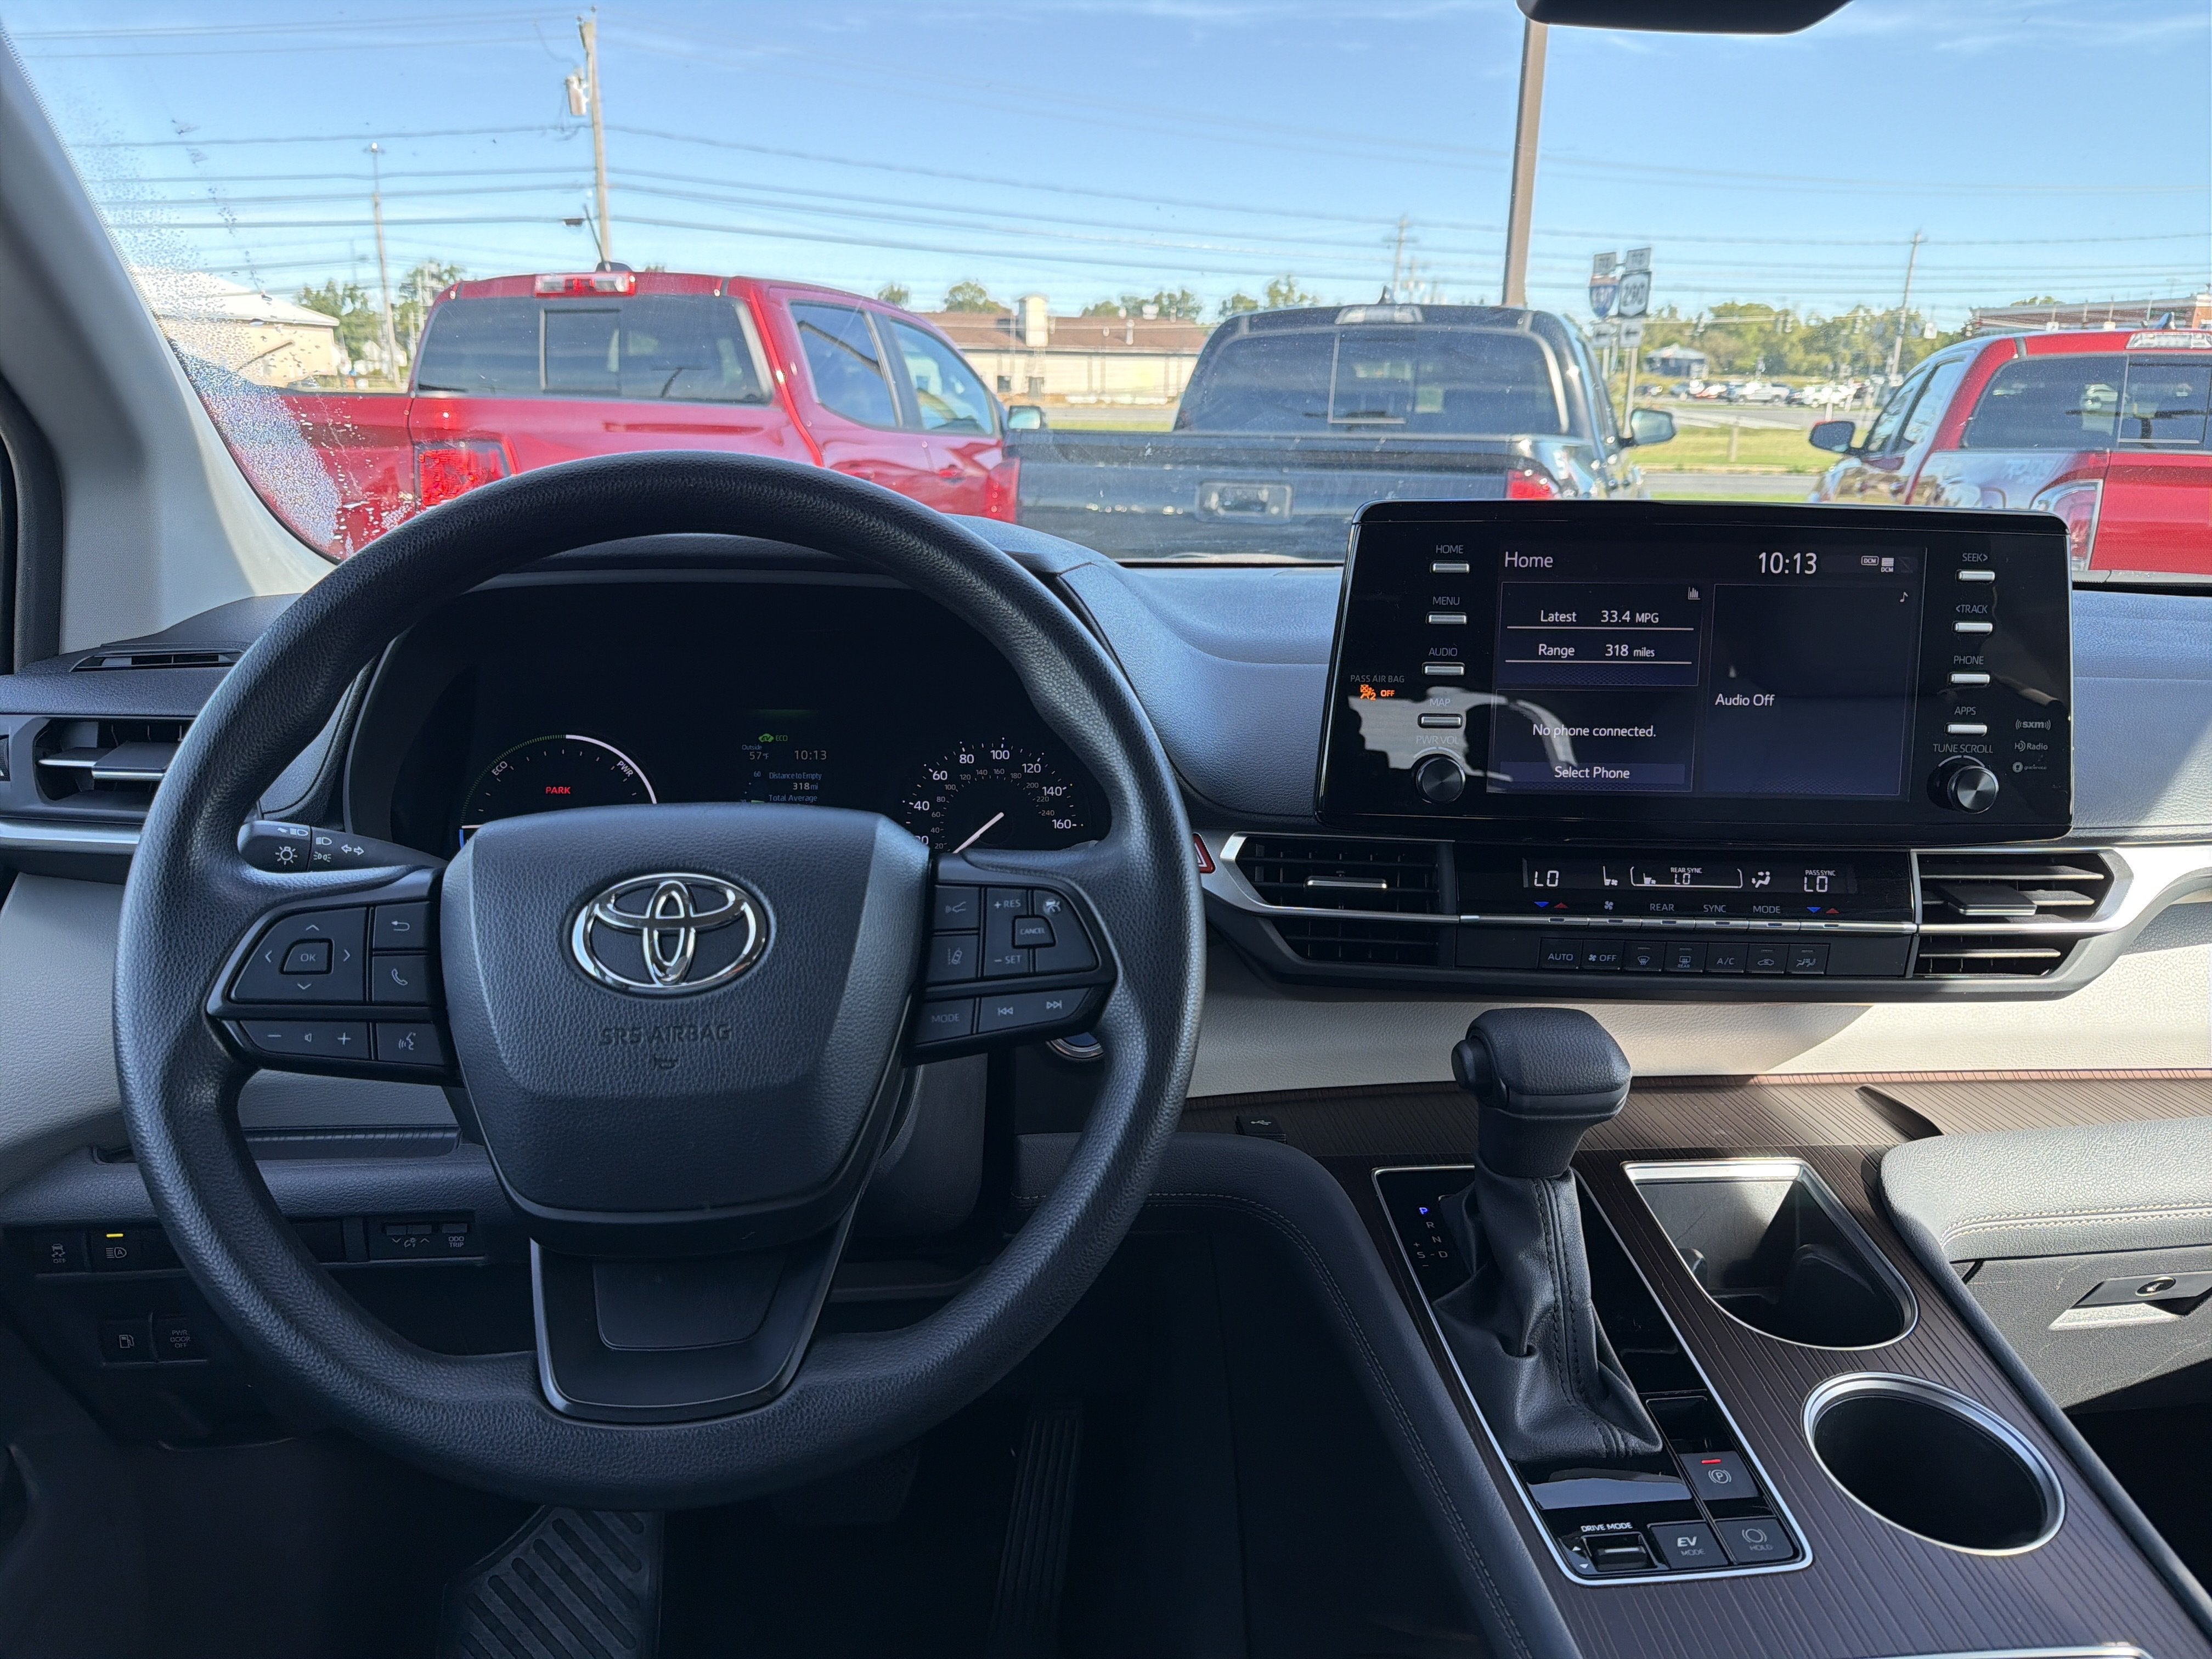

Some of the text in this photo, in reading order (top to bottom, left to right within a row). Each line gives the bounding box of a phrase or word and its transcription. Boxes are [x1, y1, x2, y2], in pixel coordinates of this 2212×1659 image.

[1435, 545, 1464, 554] HOME
[1504, 551, 1554, 568] Home
[1758, 551, 1817, 575] 10:13
[1432, 596, 1460, 606] MENU
[1540, 610, 1659, 624] Latest 33.4 MPG
[1429, 647, 1458, 657] AUDIO
[1538, 644, 1656, 659] Range 318 miles
[1954, 656, 1984, 665] PHONE
[1350, 675, 1405, 683] PASS AIR BAG
[1430, 698, 1451, 707] MAP
[1715, 693, 1775, 707] Audio Off
[1954, 706, 1976, 715] APPS
[1532, 724, 1657, 740] No phone connected.
[1416, 735, 1459, 744] PWR VOL
[1933, 744, 1994, 754] TUNE SCROLL
[2027, 742, 2049, 751] Radio
[794, 750, 827, 760] 10:13
[959, 754, 975, 764] 80
[990, 750, 1010, 760] 100
[492, 760, 509, 777] ECO
[616, 760, 634, 777] PWR
[1022, 764, 1041, 774] 120
[1554, 766, 1630, 779] Select Phone
[769, 771, 795, 780] Distance
[803, 772, 822, 781] Empty
[933, 771, 948, 781] 60
[545, 786, 571, 794] PARK
[1042, 786, 1062, 797] 140
[788, 794, 818, 803] Average
[913, 800, 930, 811] 40
[1052, 819, 1071, 830] 160
[1534, 870, 1559, 887] LO
[1674, 872, 1691, 885] LO
[1803, 876, 1828, 893] LO
[1650, 903, 1675, 913] REAR
[1703, 904, 1726, 913] SYNC
[1753, 905, 1781, 915] MODE
[300, 953, 317, 962] OK
[1548, 952, 1574, 962] AUTO
[1599, 953, 1617, 963] OFF
[1716, 956, 1735, 967] A/C
[932, 1013, 961, 1023] MODE
[602, 1023, 733, 1044] SRS AIRBAG
[1432, 1235, 1442, 1244] N
[1581, 1522, 1633, 1532] DRIVE MODE
[1677, 1536, 1697, 1547] EV
[1680, 1548, 1706, 1556] MODE
